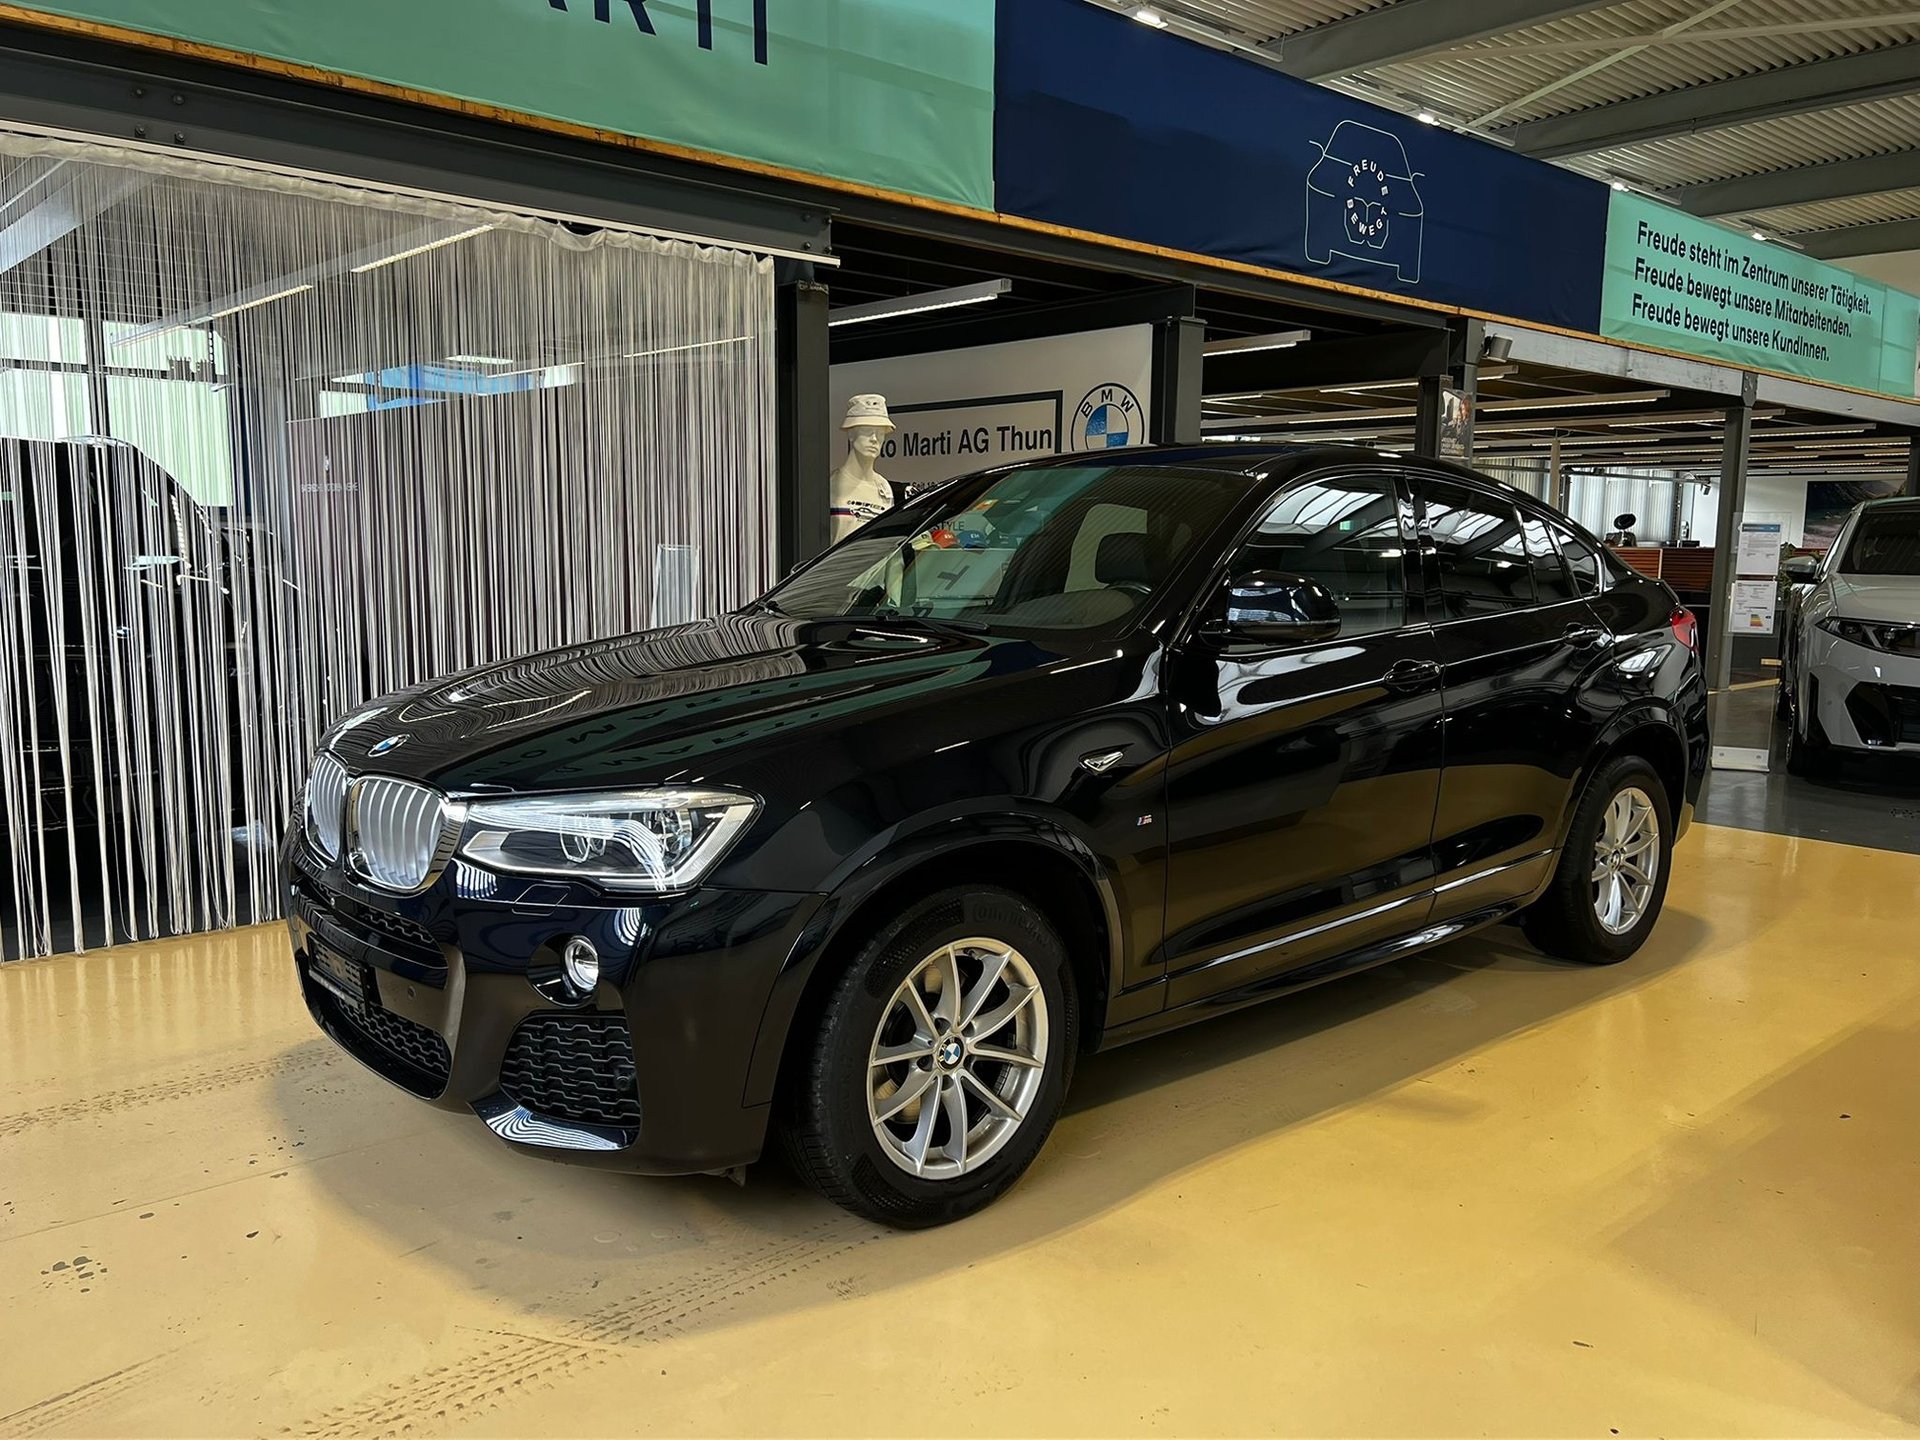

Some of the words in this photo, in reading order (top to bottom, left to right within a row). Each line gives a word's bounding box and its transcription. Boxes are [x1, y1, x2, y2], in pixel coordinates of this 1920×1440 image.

[1347, 159, 1389, 196] FREUDE
[1346, 199, 1388, 236] BEWEGT
[1637, 220, 1686, 258] Freude
[1689, 242, 1721, 270] steht
[1724, 249, 1739, 275] im
[1741, 256, 1789, 290] Zentrum
[1791, 276, 1829, 302] unserer
[1831, 284, 1872, 315] Tätigkeit.
[1634, 257, 1684, 293] Freude
[1686, 272, 1732, 309] bewegt
[1734, 292, 1772, 317] unsere
[1774, 298, 1852, 338] Mitarbeitenden.
[1632, 293, 1681, 327] Freude
[1684, 307, 1730, 342] bewegt
[1732, 323, 1769, 348] unsere
[1771, 329, 1830, 361] KundInnen.
[1081, 388, 1134, 418] BMW
[903, 429, 951, 457] Marti
[957, 427, 989, 454] AG
[996, 425, 1052, 452] Thun
